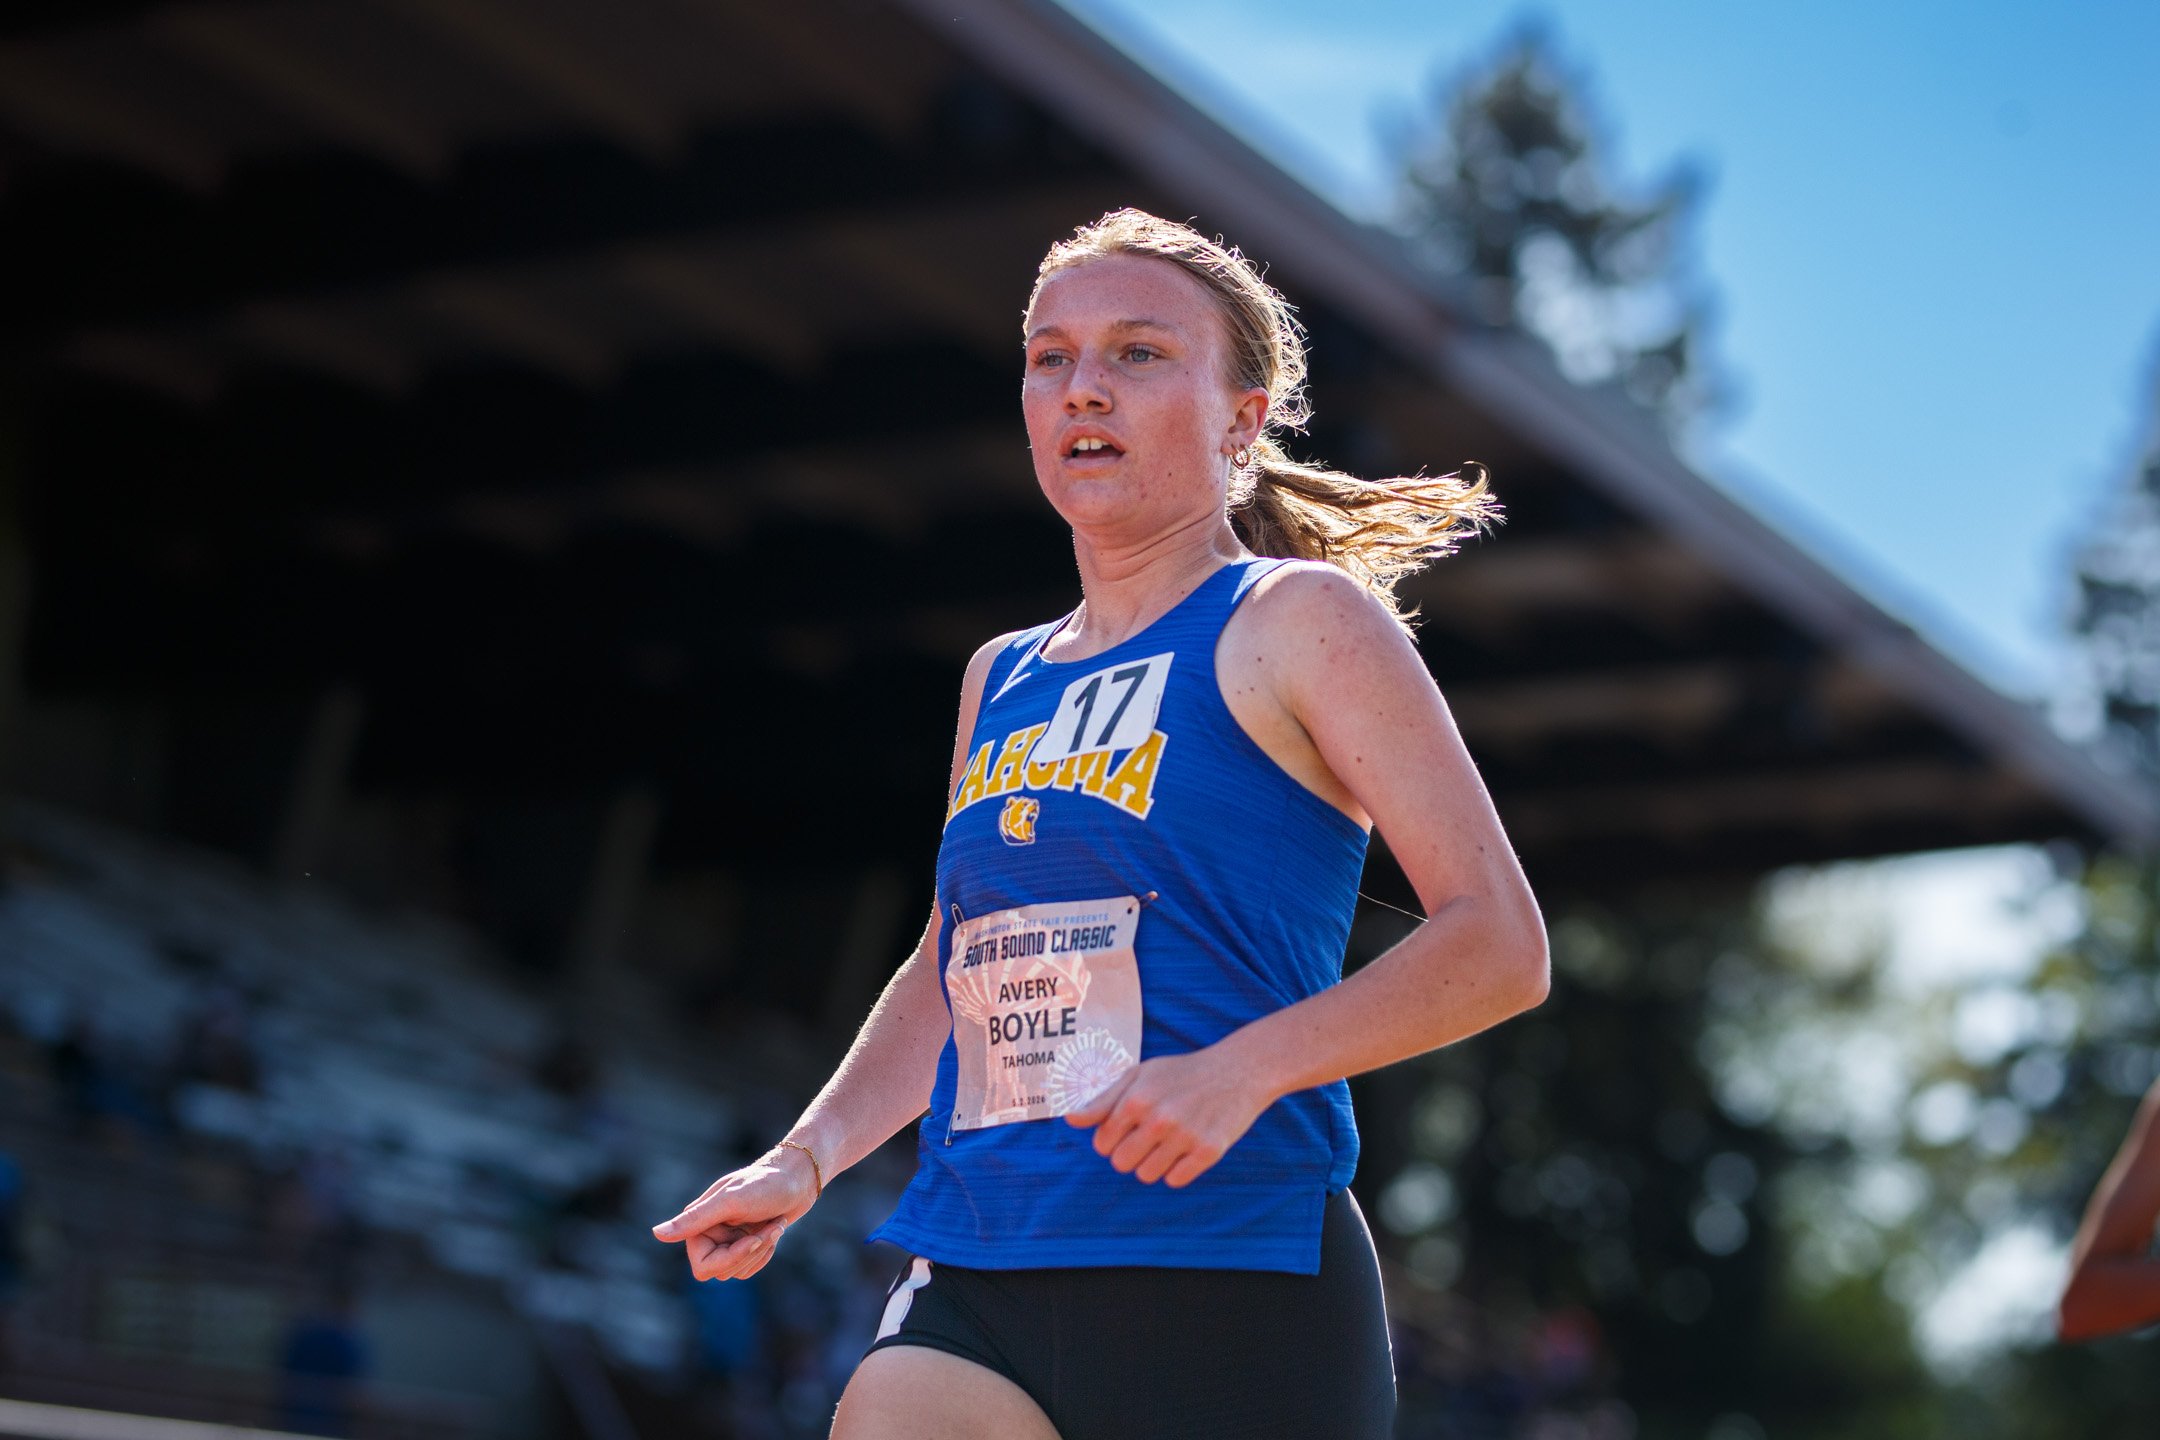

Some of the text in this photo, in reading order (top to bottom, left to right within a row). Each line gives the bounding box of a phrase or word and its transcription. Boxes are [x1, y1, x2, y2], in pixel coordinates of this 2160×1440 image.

[1068, 663, 1150, 753] 17
[947, 720, 1168, 820] AHMA
[1014, 918, 1037, 929] STATE
[1041, 916, 1060, 926] FAIR
[1064, 913, 1109, 924] PRESENTS
[964, 925, 1116, 968] SOUTH SOUND CLASSIC
[999, 977, 1058, 1003] AVERY
[989, 1007, 1076, 1045] BOYLE
[1002, 1051, 1055, 1069] TAHOMA
